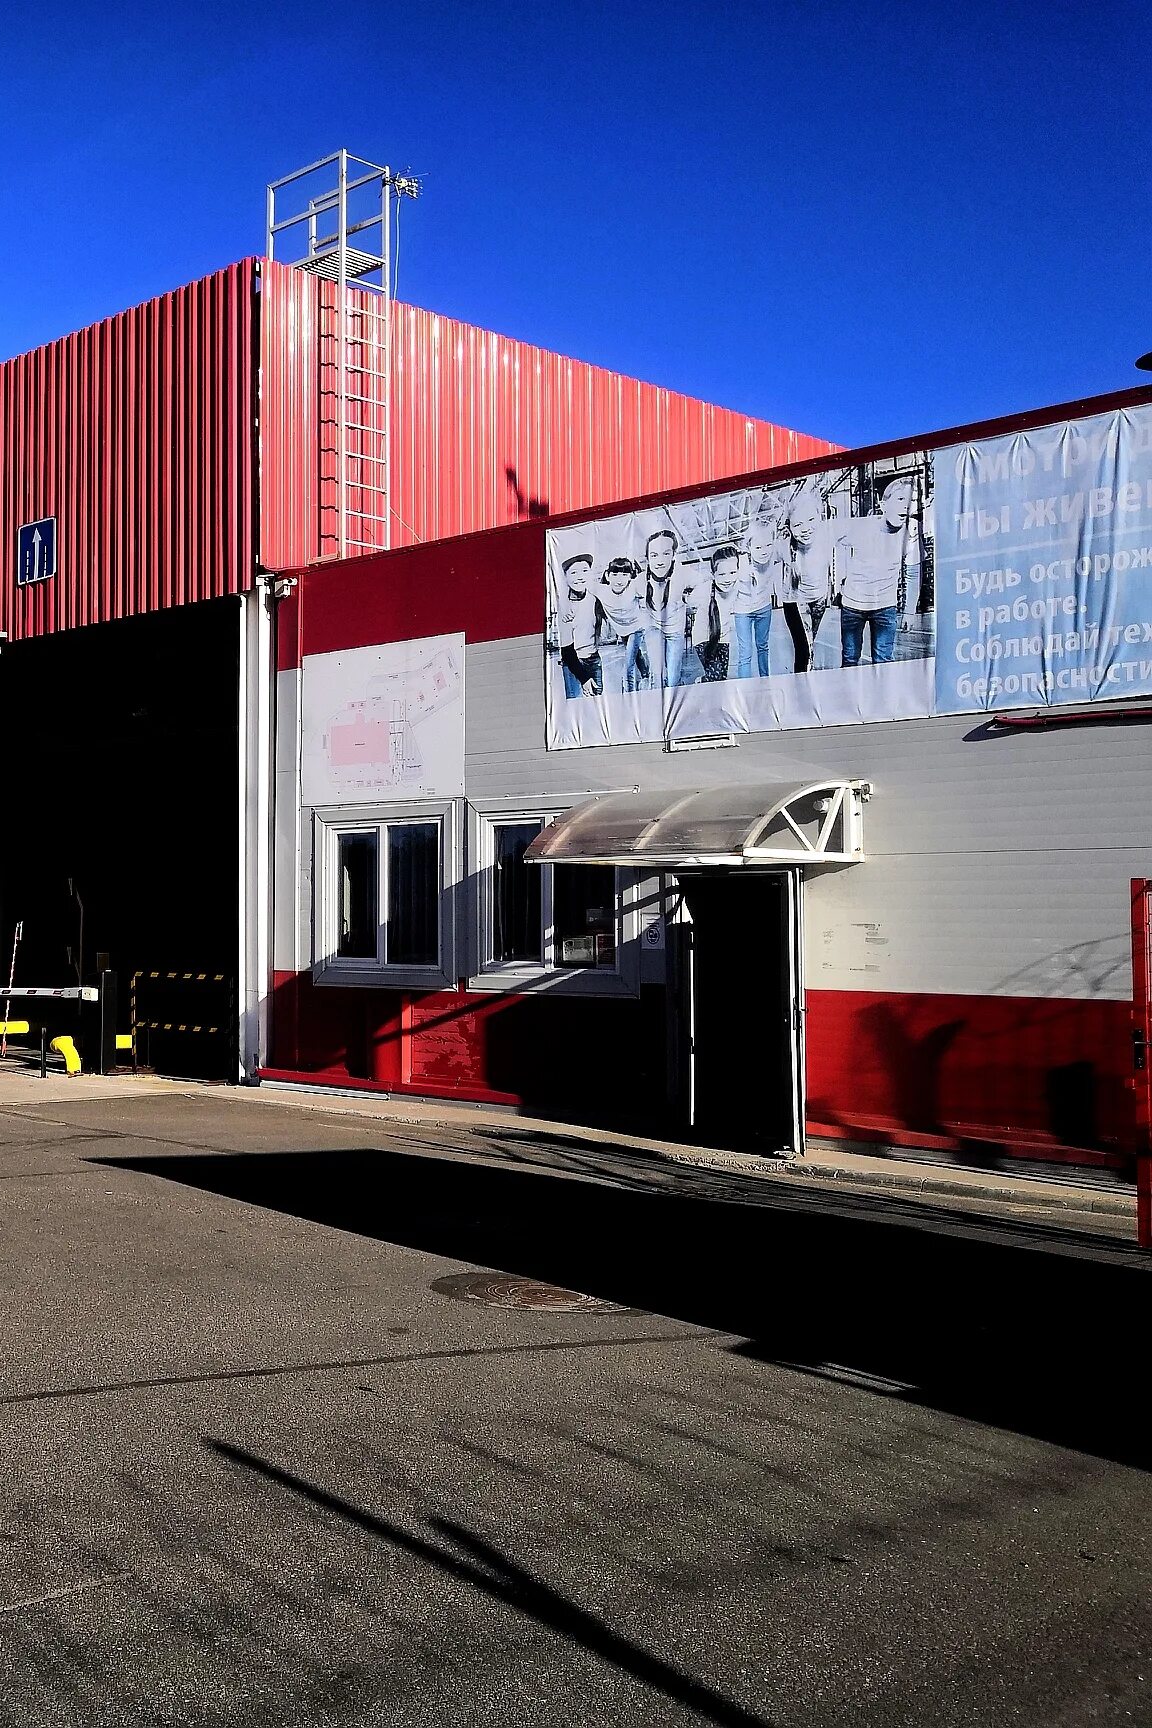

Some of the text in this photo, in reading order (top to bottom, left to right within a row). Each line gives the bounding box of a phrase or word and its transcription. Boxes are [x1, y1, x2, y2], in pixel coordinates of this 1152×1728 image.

[955, 479, 1152, 540] ты живе
[956, 568, 1022, 599] Будь
[956, 594, 1088, 633] в работе.
[956, 621, 1099, 663] Соблюдай
